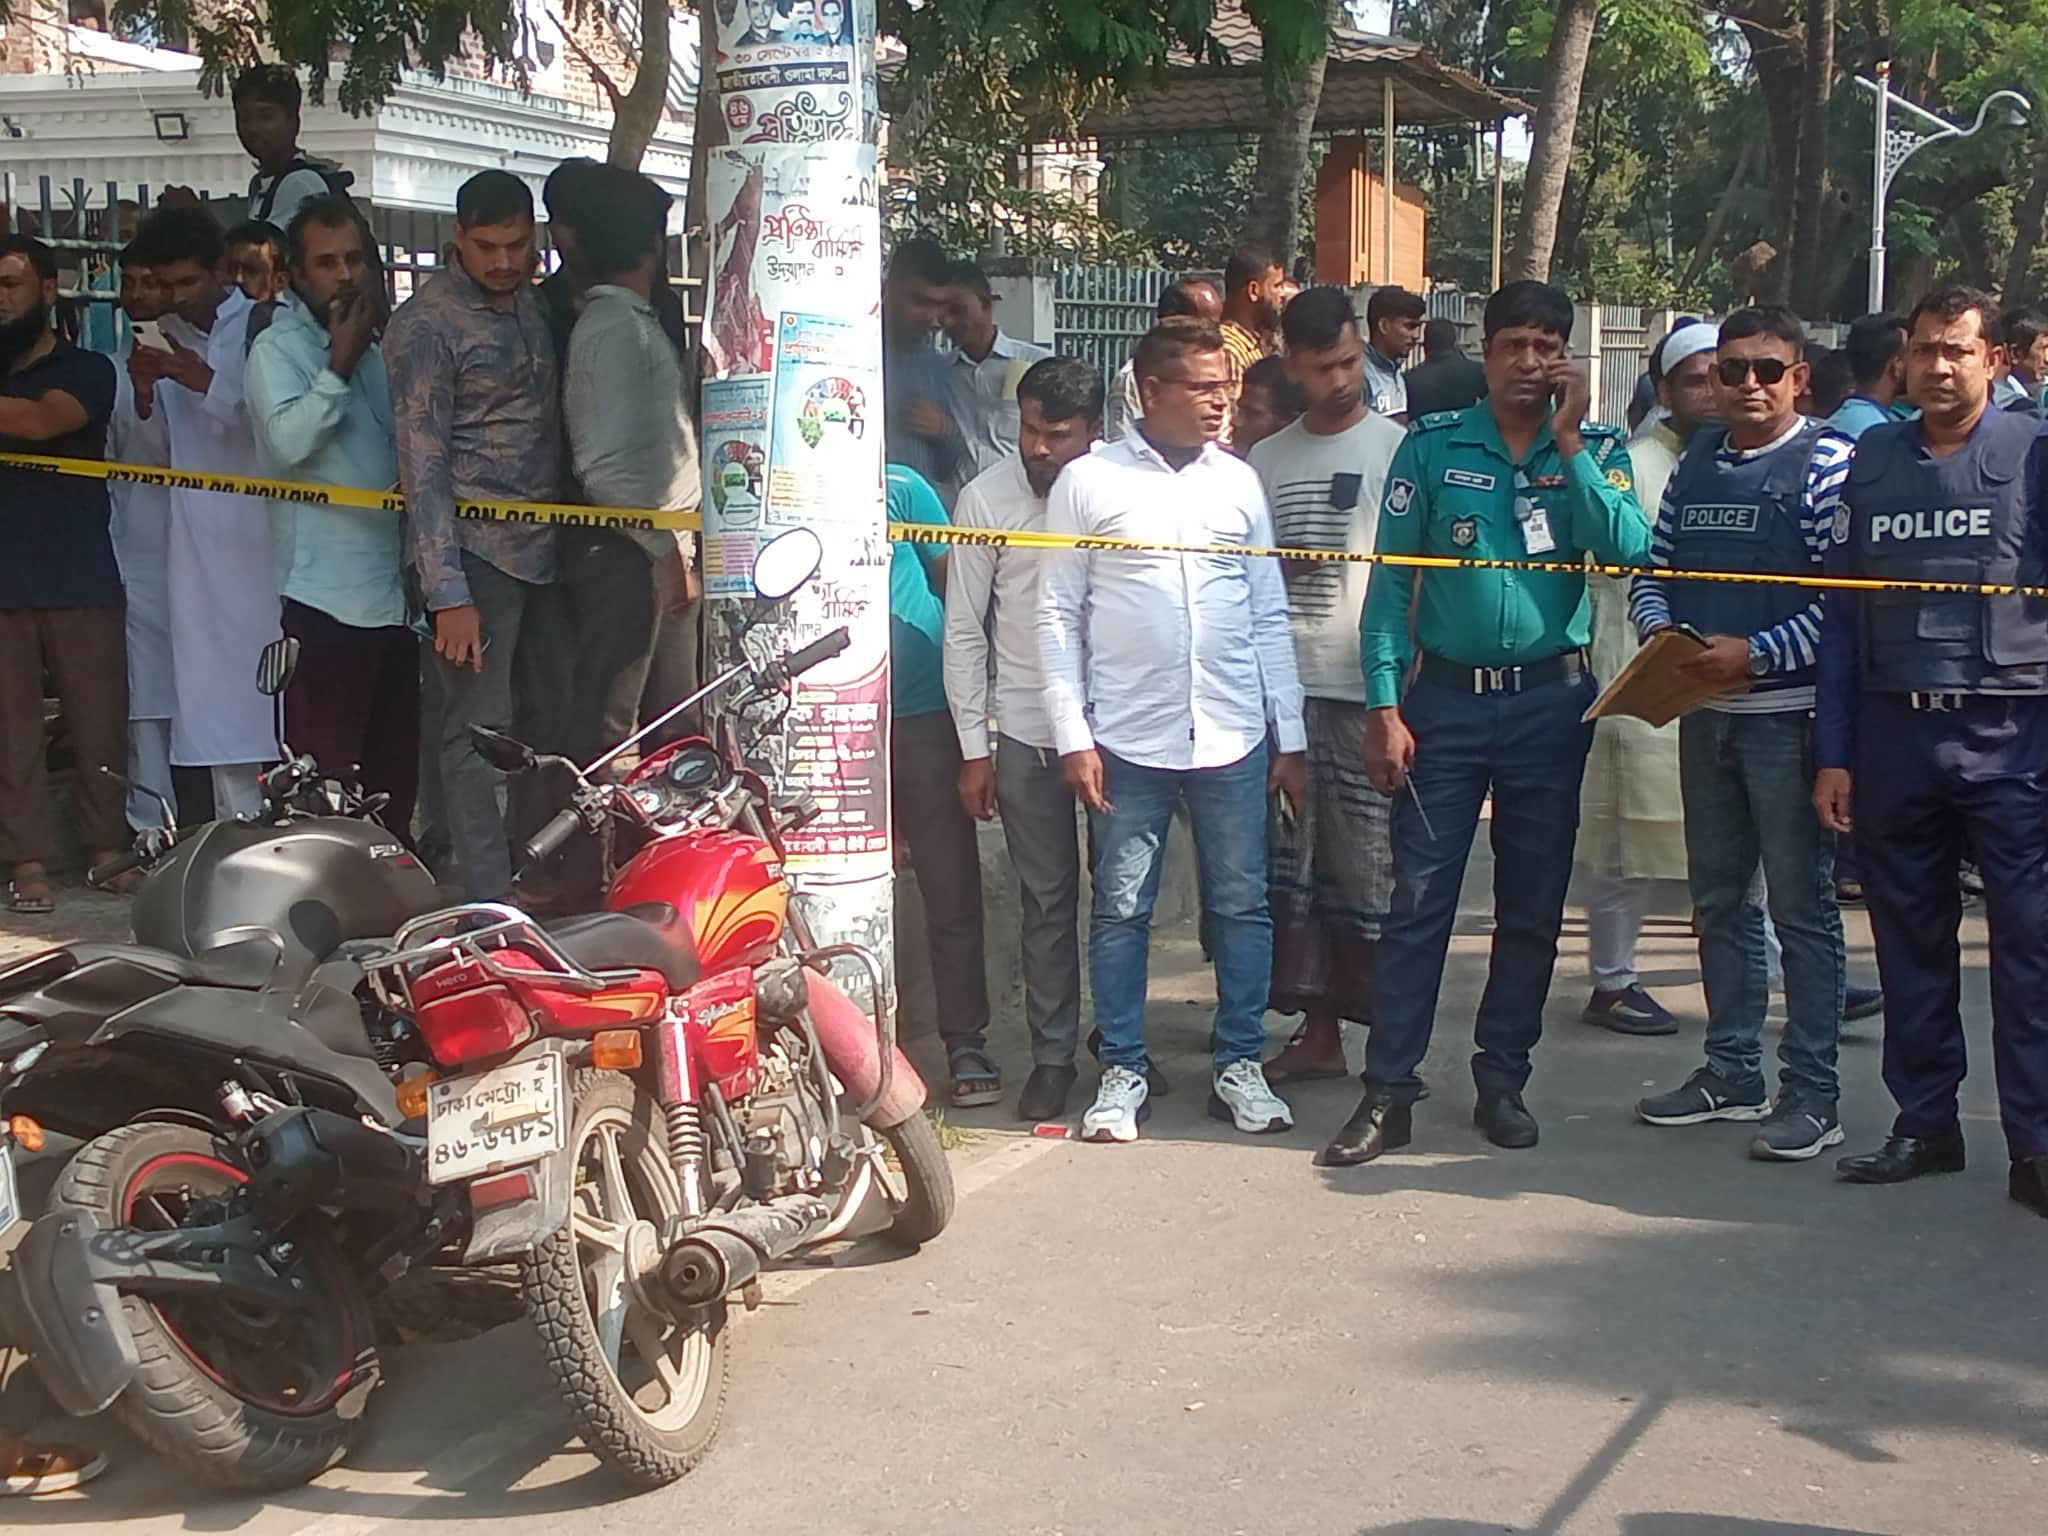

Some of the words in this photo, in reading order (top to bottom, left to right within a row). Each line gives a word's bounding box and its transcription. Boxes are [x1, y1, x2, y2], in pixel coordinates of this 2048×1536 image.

[1687, 509, 1750, 526] POLICE
[1871, 509, 1992, 542] POLICE
[437, 1095, 472, 1118] ঢাকা
